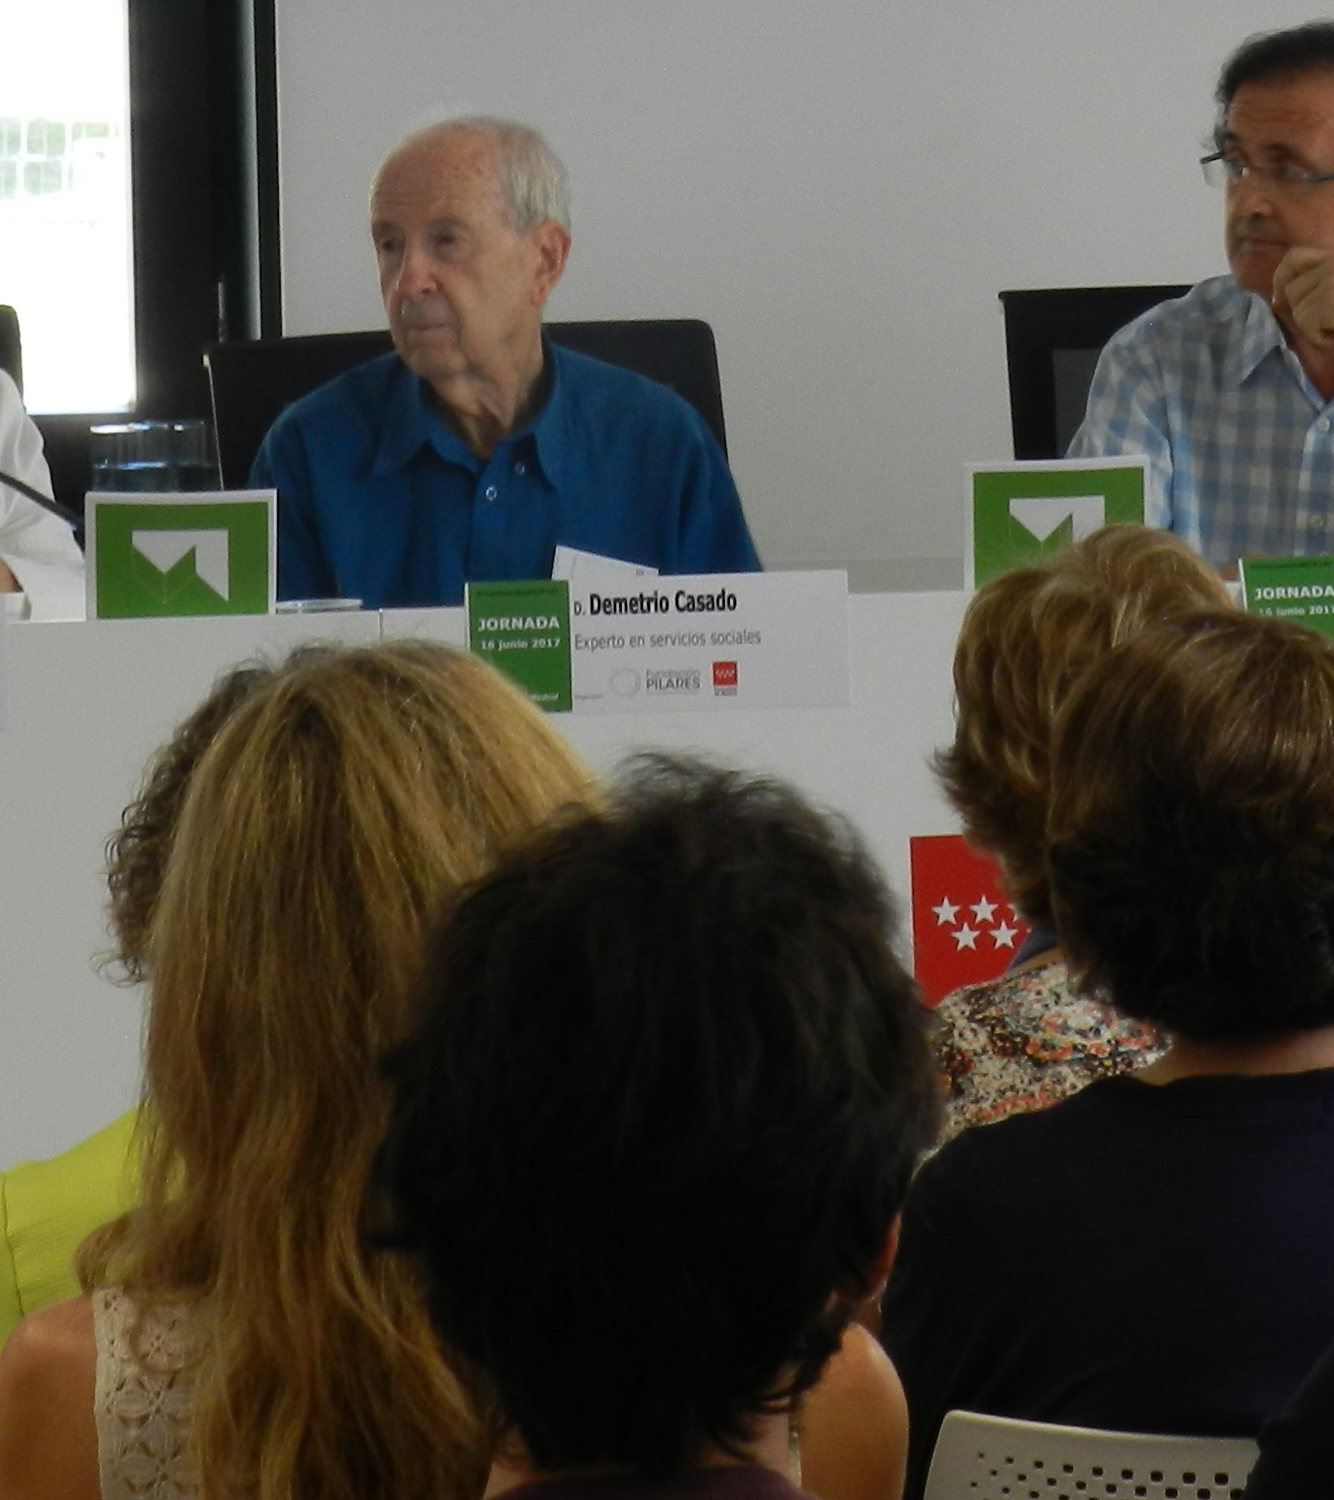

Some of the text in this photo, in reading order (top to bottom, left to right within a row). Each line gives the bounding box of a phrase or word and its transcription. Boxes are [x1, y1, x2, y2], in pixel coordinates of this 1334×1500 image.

[573, 588, 738, 616] D. Demetrio Casado
[478, 615, 560, 632] JORNADA
[498, 639, 529, 652] junio
[531, 637, 561, 649] 2017
[574, 629, 762, 653] Experto en servicios sociales
[646, 678, 700, 690] PILARES
